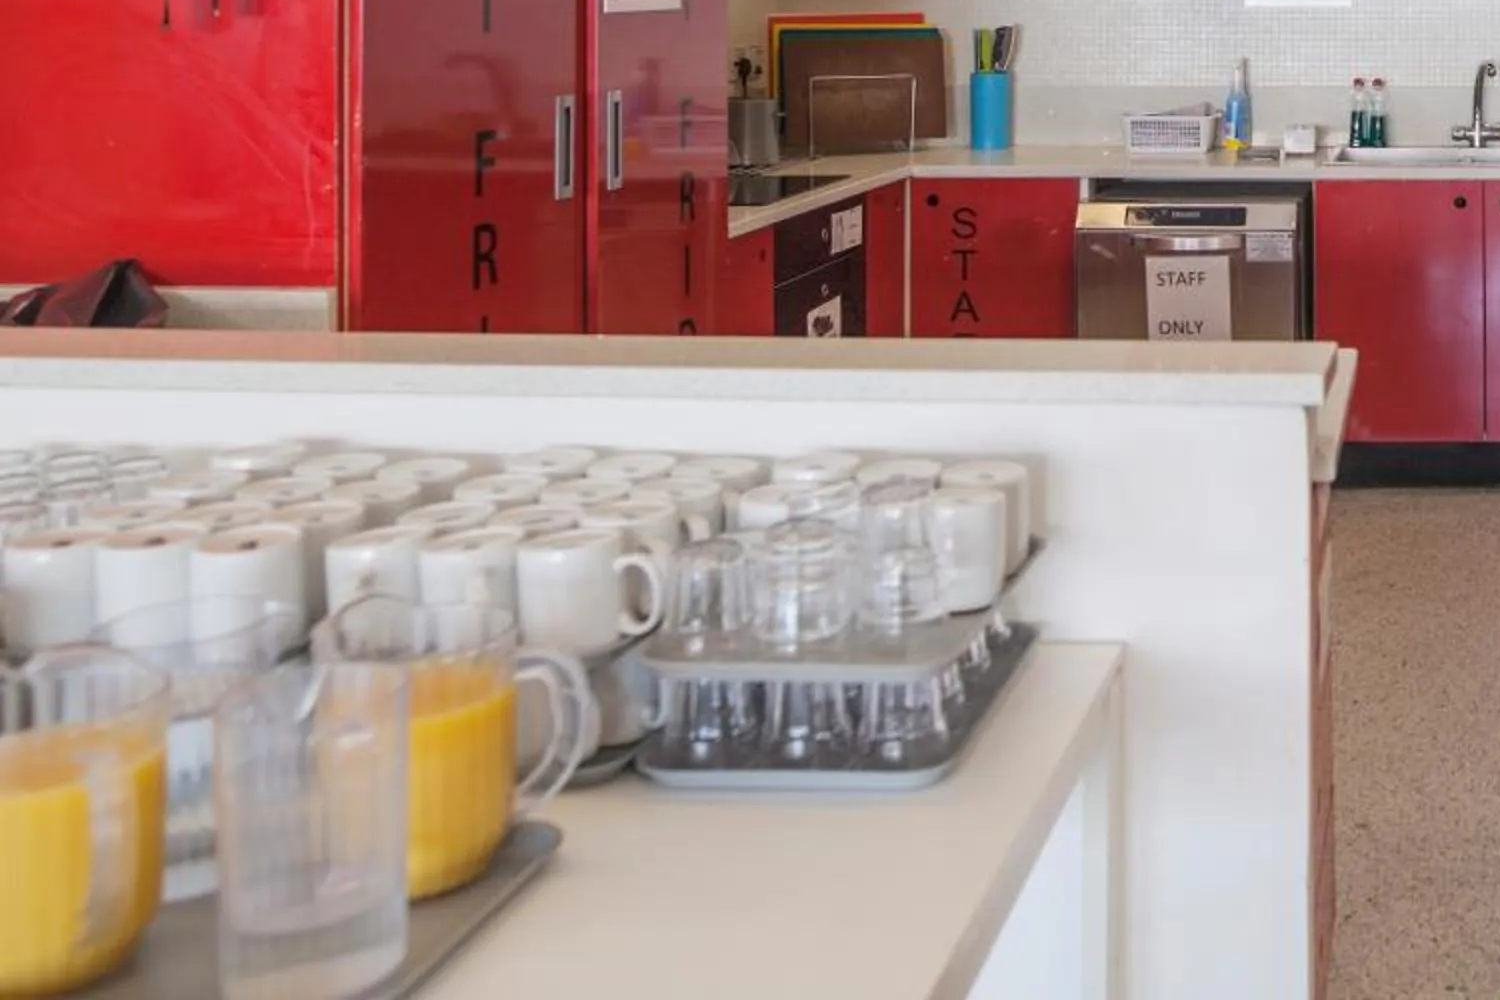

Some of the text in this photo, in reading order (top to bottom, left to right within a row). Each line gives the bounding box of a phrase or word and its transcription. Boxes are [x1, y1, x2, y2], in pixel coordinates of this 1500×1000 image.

[951, 207, 981, 337] STA
[1156, 271, 1208, 287] STAFF
[1158, 320, 1204, 336] ONLY
